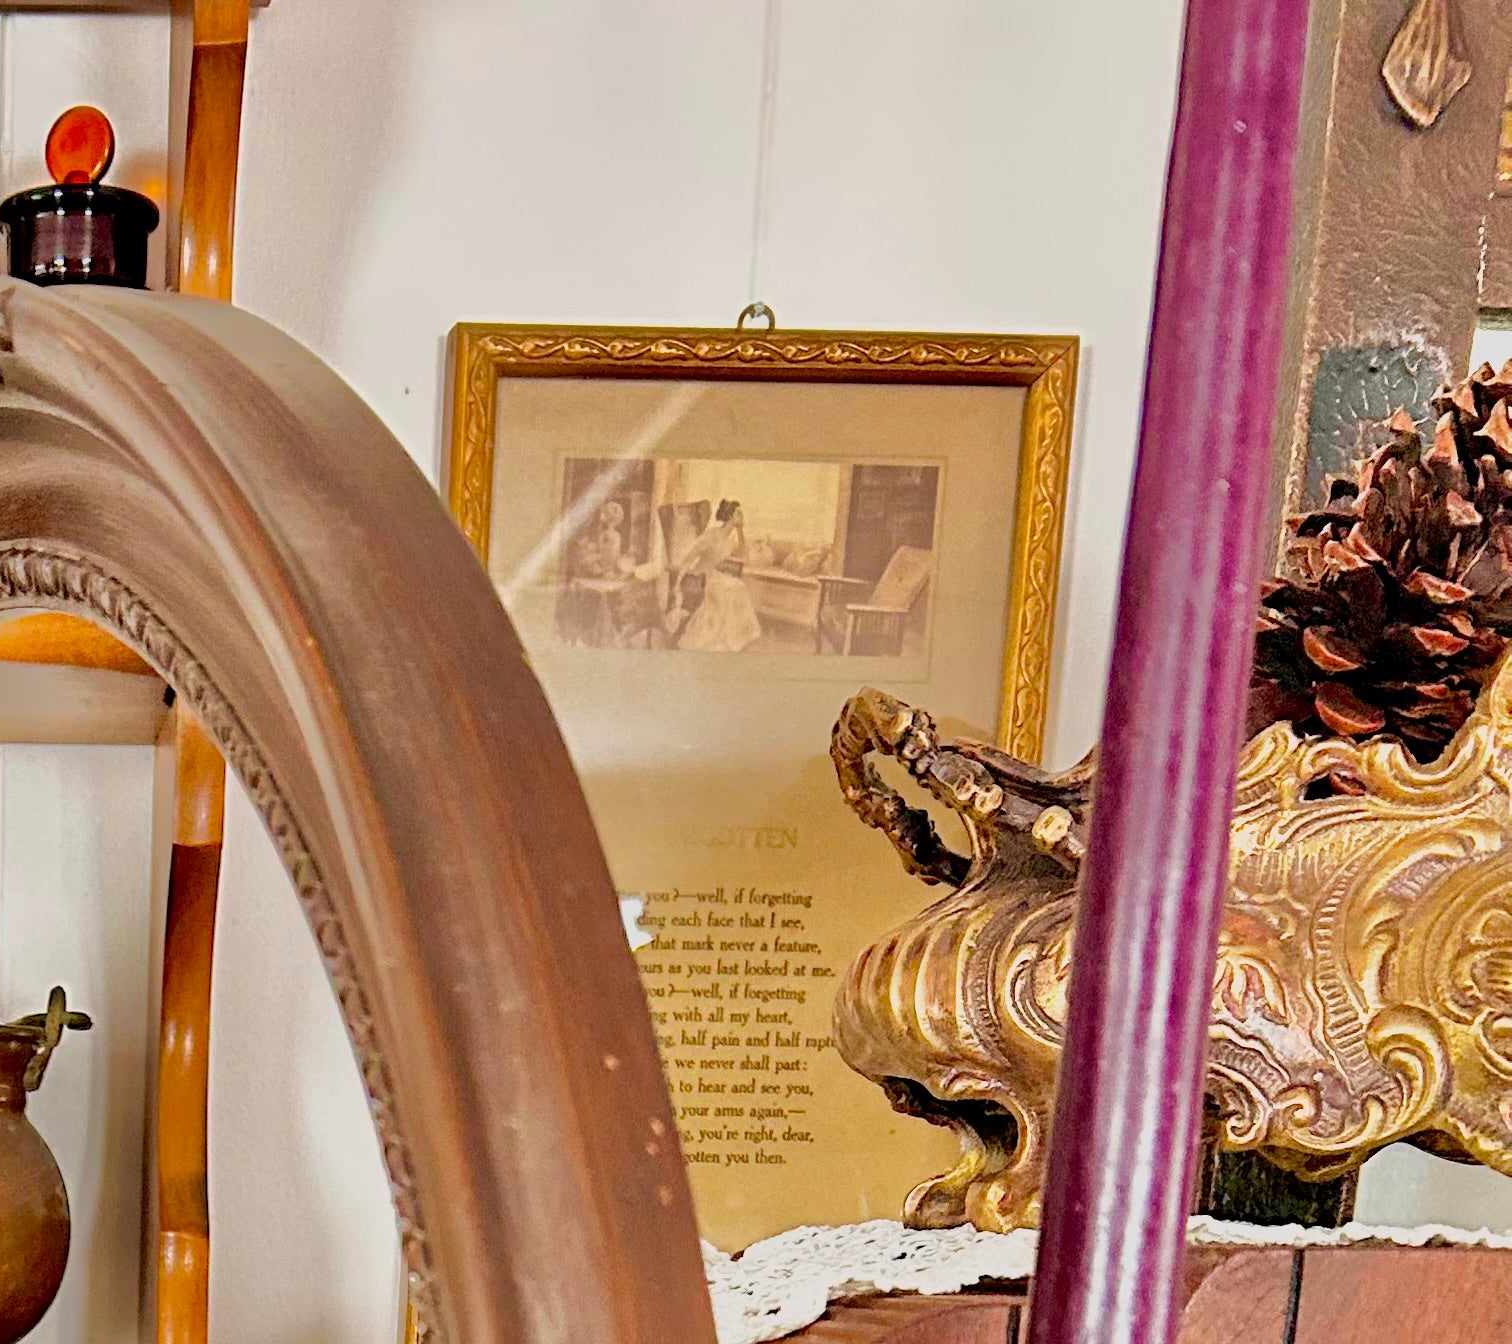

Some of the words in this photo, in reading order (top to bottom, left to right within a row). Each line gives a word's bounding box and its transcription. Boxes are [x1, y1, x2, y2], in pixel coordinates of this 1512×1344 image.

[734, 888, 745, 903] if
[749, 887, 813, 908] forgetting
[671, 911, 702, 927] each
[707, 911, 734, 927] face
[740, 912, 766, 928] that
[780, 918, 805, 931] see,
[650, 933, 676, 950] that
[681, 934, 714, 950] mark
[719, 940, 755, 952] never
[760, 940, 768, 952] a
[774, 936, 822, 954] feature,
[668, 963, 682, 974] as
[686, 963, 712, 978] you
[717, 958, 739, 975] last
[744, 960, 788, 977] looked
[793, 963, 807, 977] at
[812, 966, 836, 978] me.
[647, 986, 665, 998] ou
[729, 983, 739, 998] if
[744, 983, 806, 1004] forgetting
[672, 1006, 703, 1022] with
[707, 1006, 724, 1022] all
[729, 1012, 750, 1026] my
[756, 1007, 793, 1026] heart,
[681, 1029, 708, 1046] half
[711, 1030, 740, 1050] pain
[745, 1031, 770, 1048] and
[775, 1031, 802, 1048] half
[675, 1059, 696, 1069] we
[700, 1058, 735, 1070] never
[739, 1055, 770, 1071] shall
[679, 1079, 693, 1093] to
[698, 1077, 726, 1093] hear
[731, 1077, 755, 1094] and
[760, 1082, 781, 1094] see
[786, 1081, 814, 1098] you,
[680, 1106, 710, 1120] your
[714, 1106, 745, 1117] arms
[744, 1125, 778, 1144] right,
[782, 1126, 814, 1144] dear,
[684, 1152, 721, 1164] otten
[726, 1152, 750, 1168] you
[755, 1148, 787, 1165] then.
